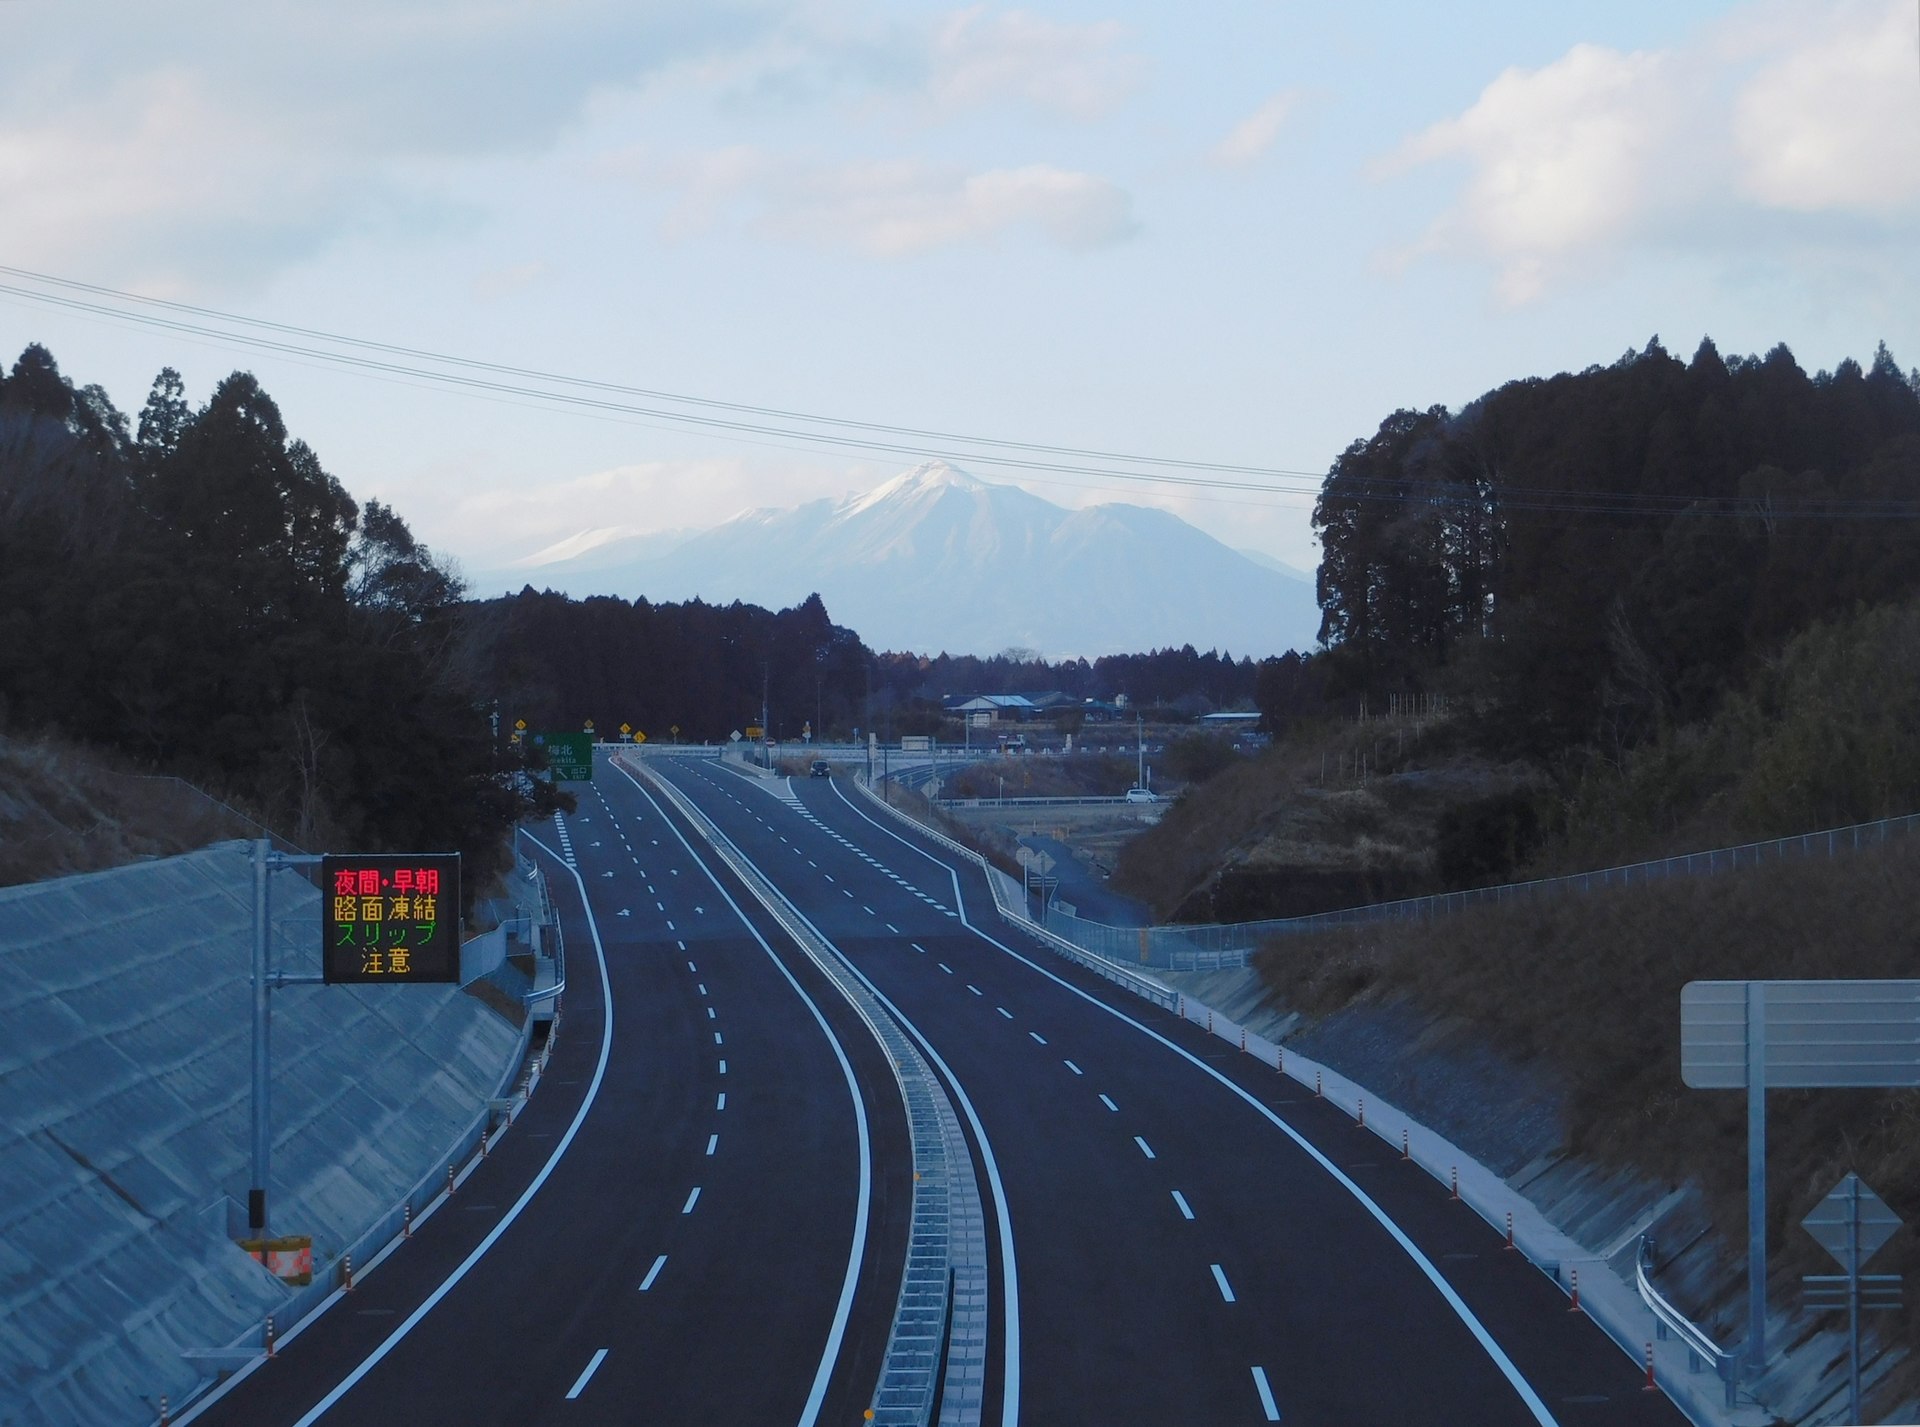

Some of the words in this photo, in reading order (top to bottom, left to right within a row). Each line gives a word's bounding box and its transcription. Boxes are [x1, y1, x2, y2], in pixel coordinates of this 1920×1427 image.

[548, 744, 573, 756] 梅北
[334, 868, 439, 895] 夜間・早朝
[334, 895, 437, 921] 路面凍結
[336, 922, 437, 946] スリップ
[361, 947, 411, 974] 注意
